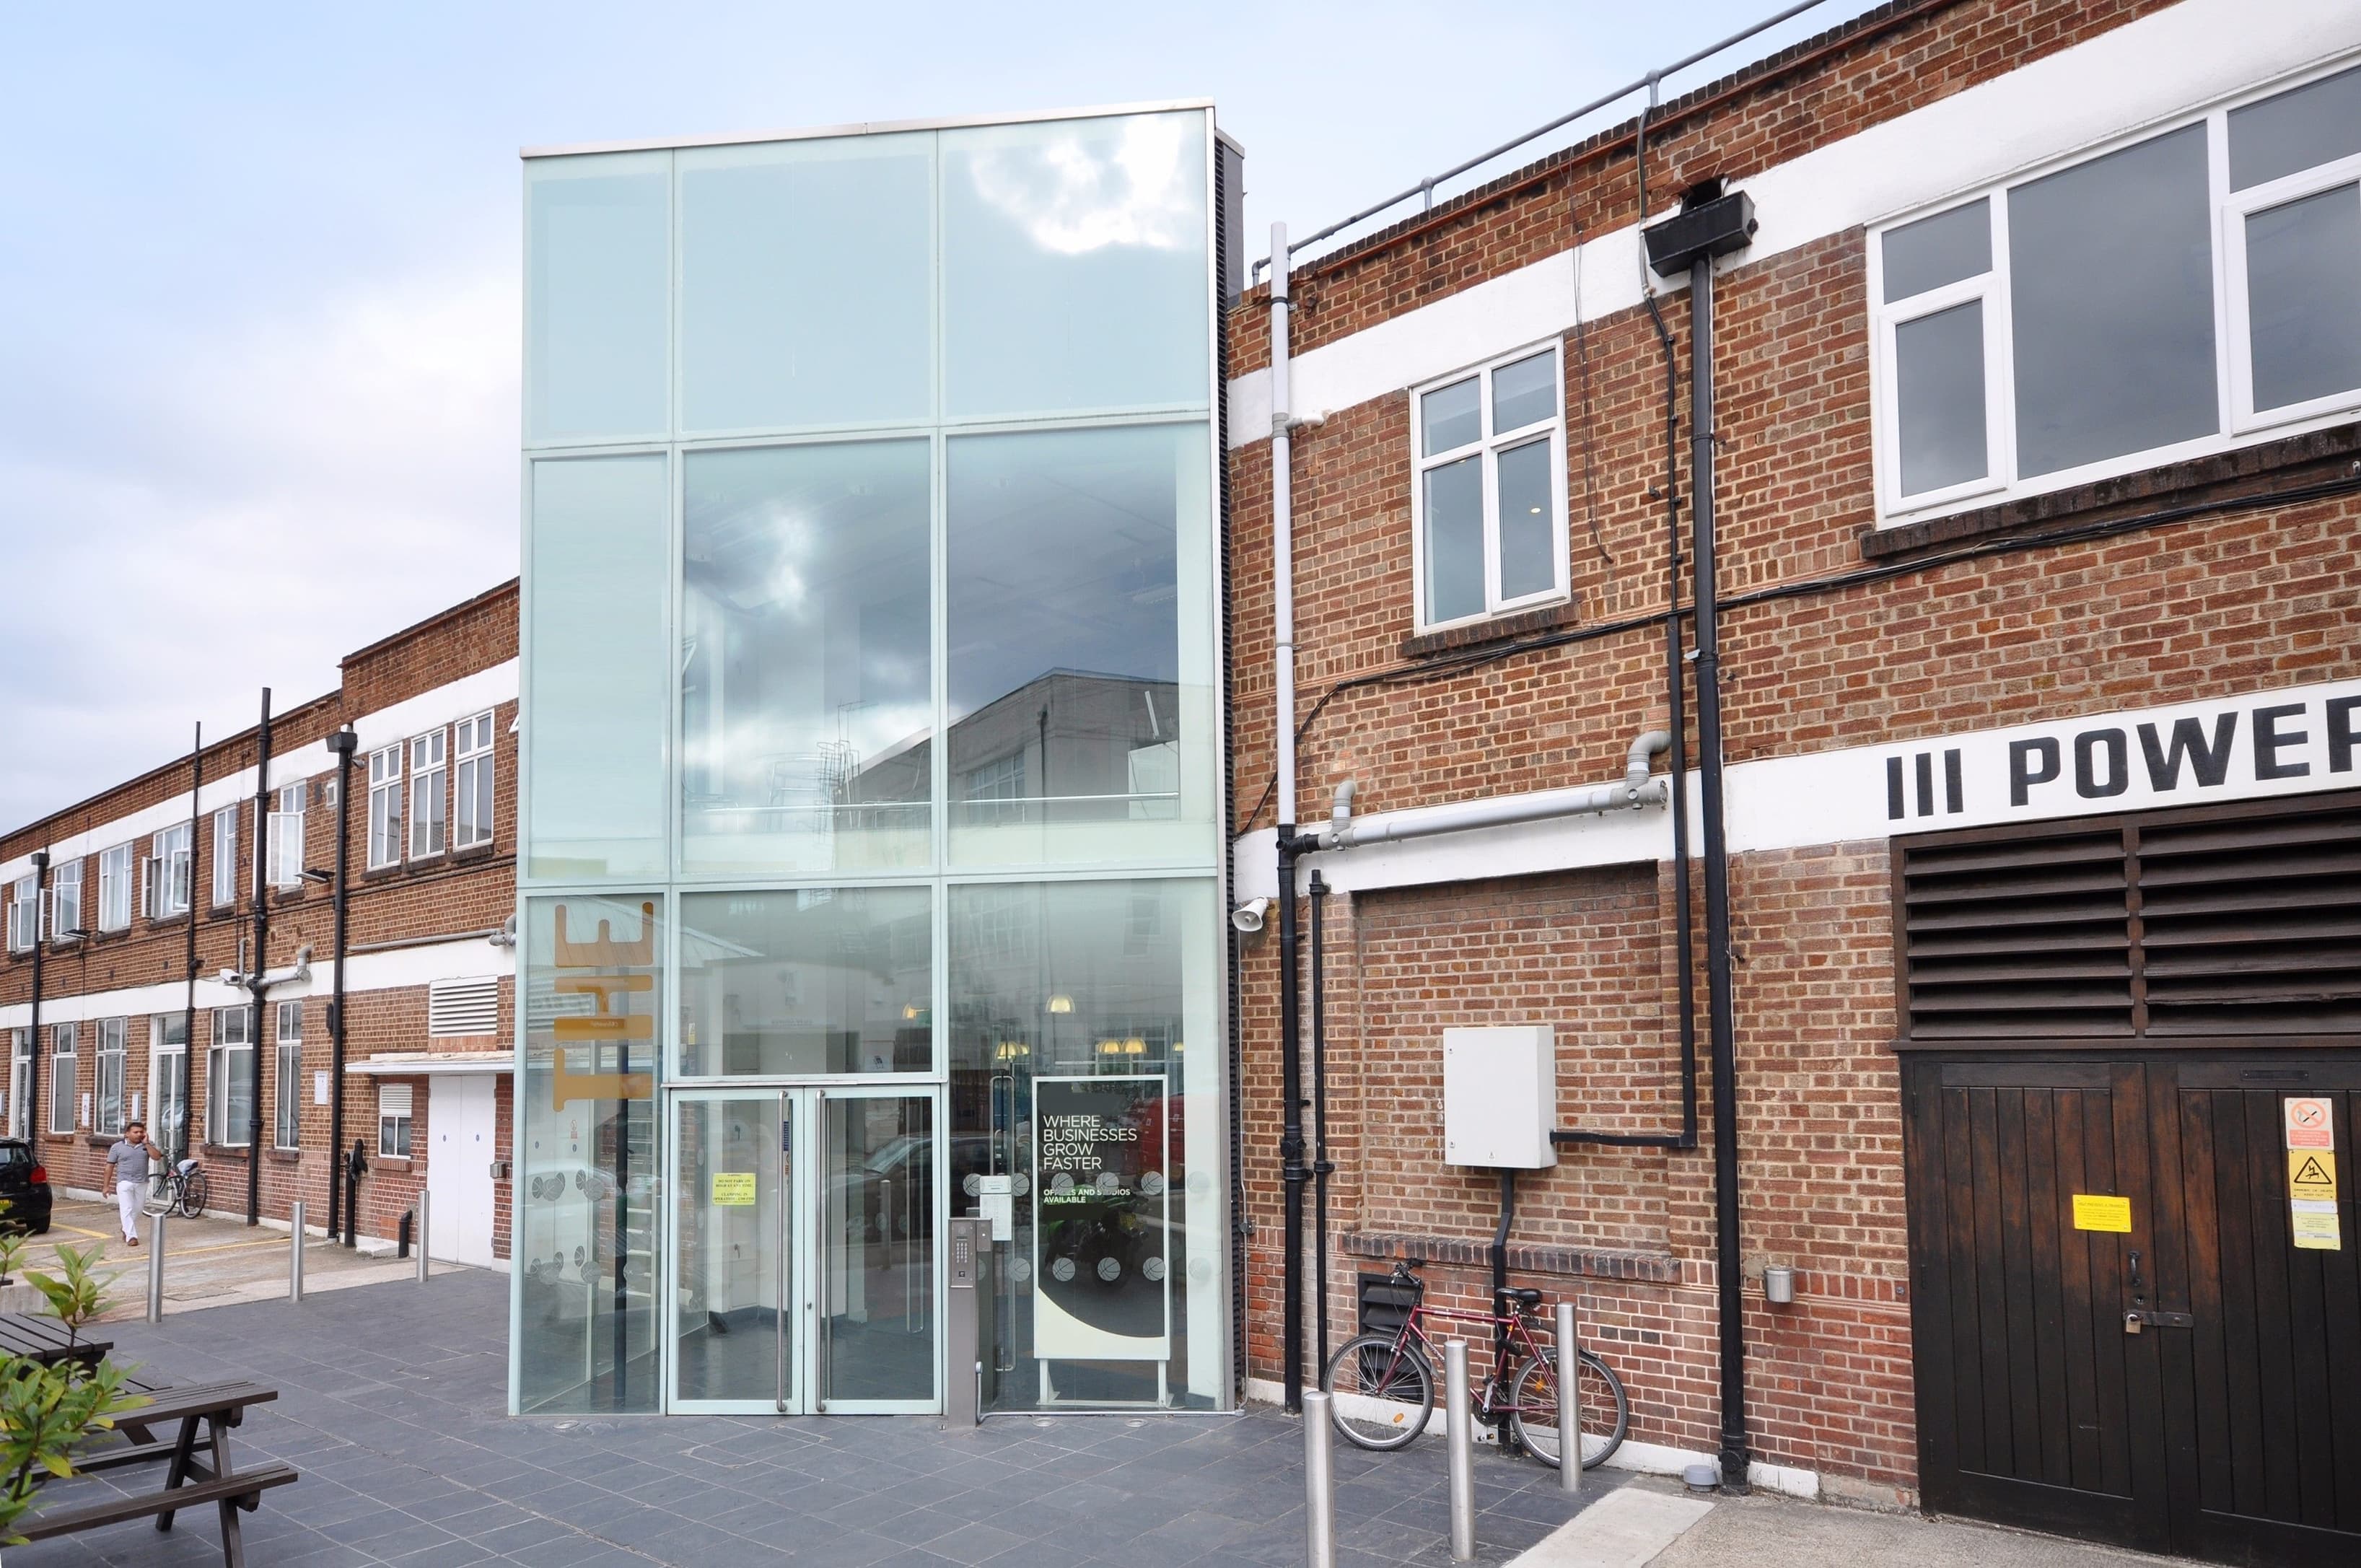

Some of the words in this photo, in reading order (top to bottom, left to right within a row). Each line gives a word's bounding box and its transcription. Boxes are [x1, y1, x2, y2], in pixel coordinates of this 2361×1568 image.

[1043, 1115, 1100, 1127] WHERE
[1043, 1129, 1137, 1142] BUSINESSES
[1043, 1143, 1094, 1155] GROW
[1043, 1157, 1102, 1170] FASTER
